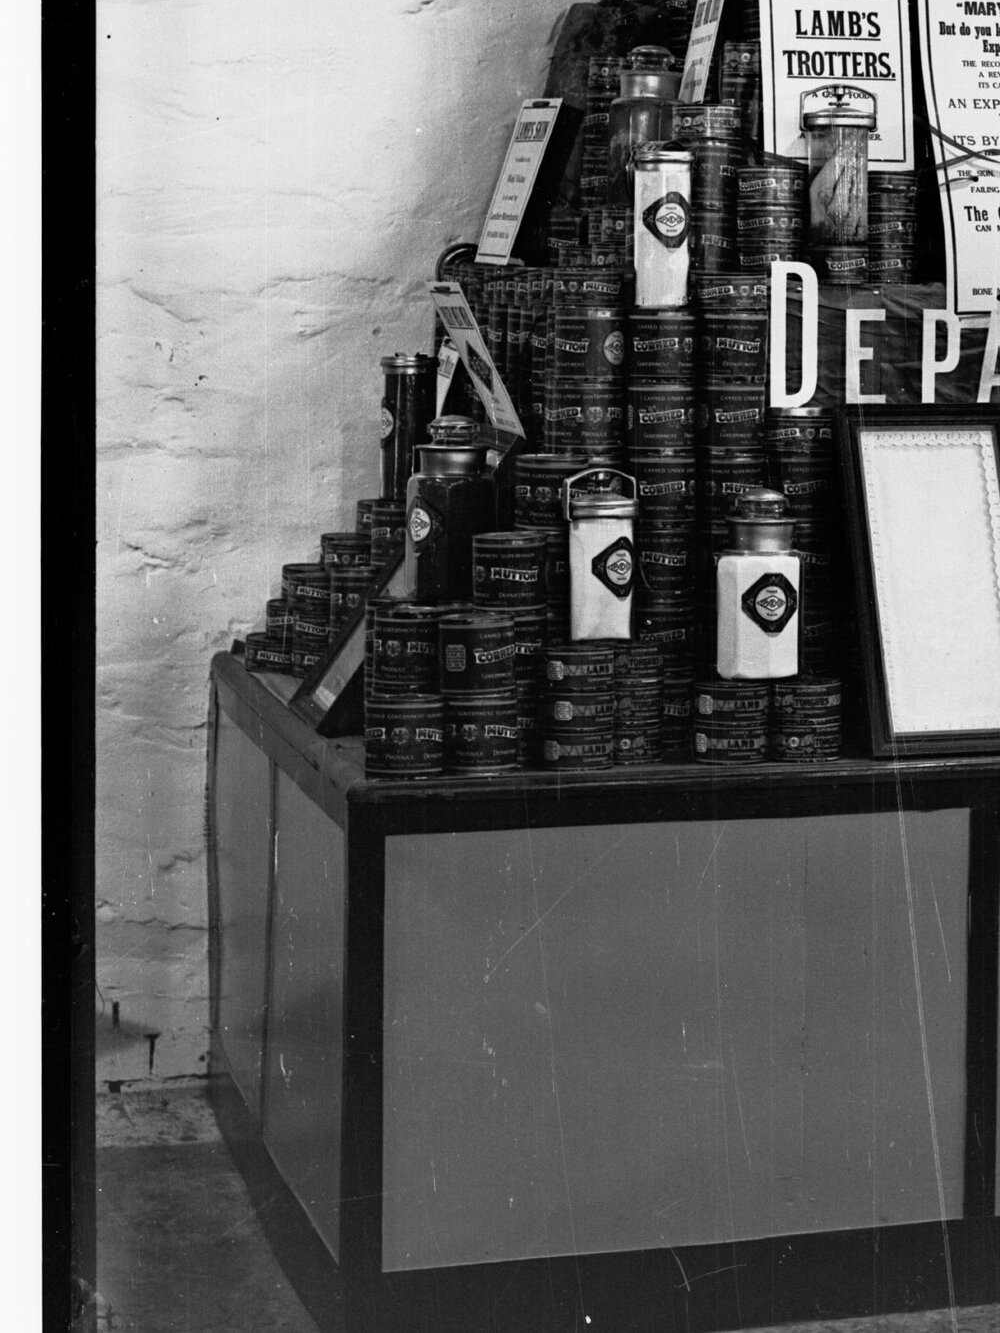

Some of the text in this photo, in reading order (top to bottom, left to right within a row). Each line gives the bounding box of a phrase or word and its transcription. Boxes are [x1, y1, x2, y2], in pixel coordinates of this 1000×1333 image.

[795, 9, 882, 38] LAMB'S
[939, 21, 956, 36] But
[960, 22, 971, 36] do
[975, 25, 991, 40] you
[782, 50, 896, 78] TROTTERS.
[962, 60, 977, 68] THE
[948, 98, 967, 109] AN
[952, 135, 976, 146] ITS
[957, 169, 972, 177] THE
[739, 177, 776, 192] CORNED
[970, 186, 1000, 194] FAILING
[964, 205, 989, 222] The
[975, 224, 991, 232] CAN
[972, 287, 993, 296] BONE
[634, 337, 679, 352] CORNED
[717, 337, 760, 353] MUTTON
[639, 409, 684, 423] CORNED
[715, 409, 759, 423] CORNED
[640, 481, 686, 495] CORNED
[641, 551, 687, 566] MUTTON
[491, 567, 539, 583] MUTTON
[734, 699, 760, 711] LAMB
[795, 696, 830, 708] TONGUES
[728, 739, 756, 750] LAMB
